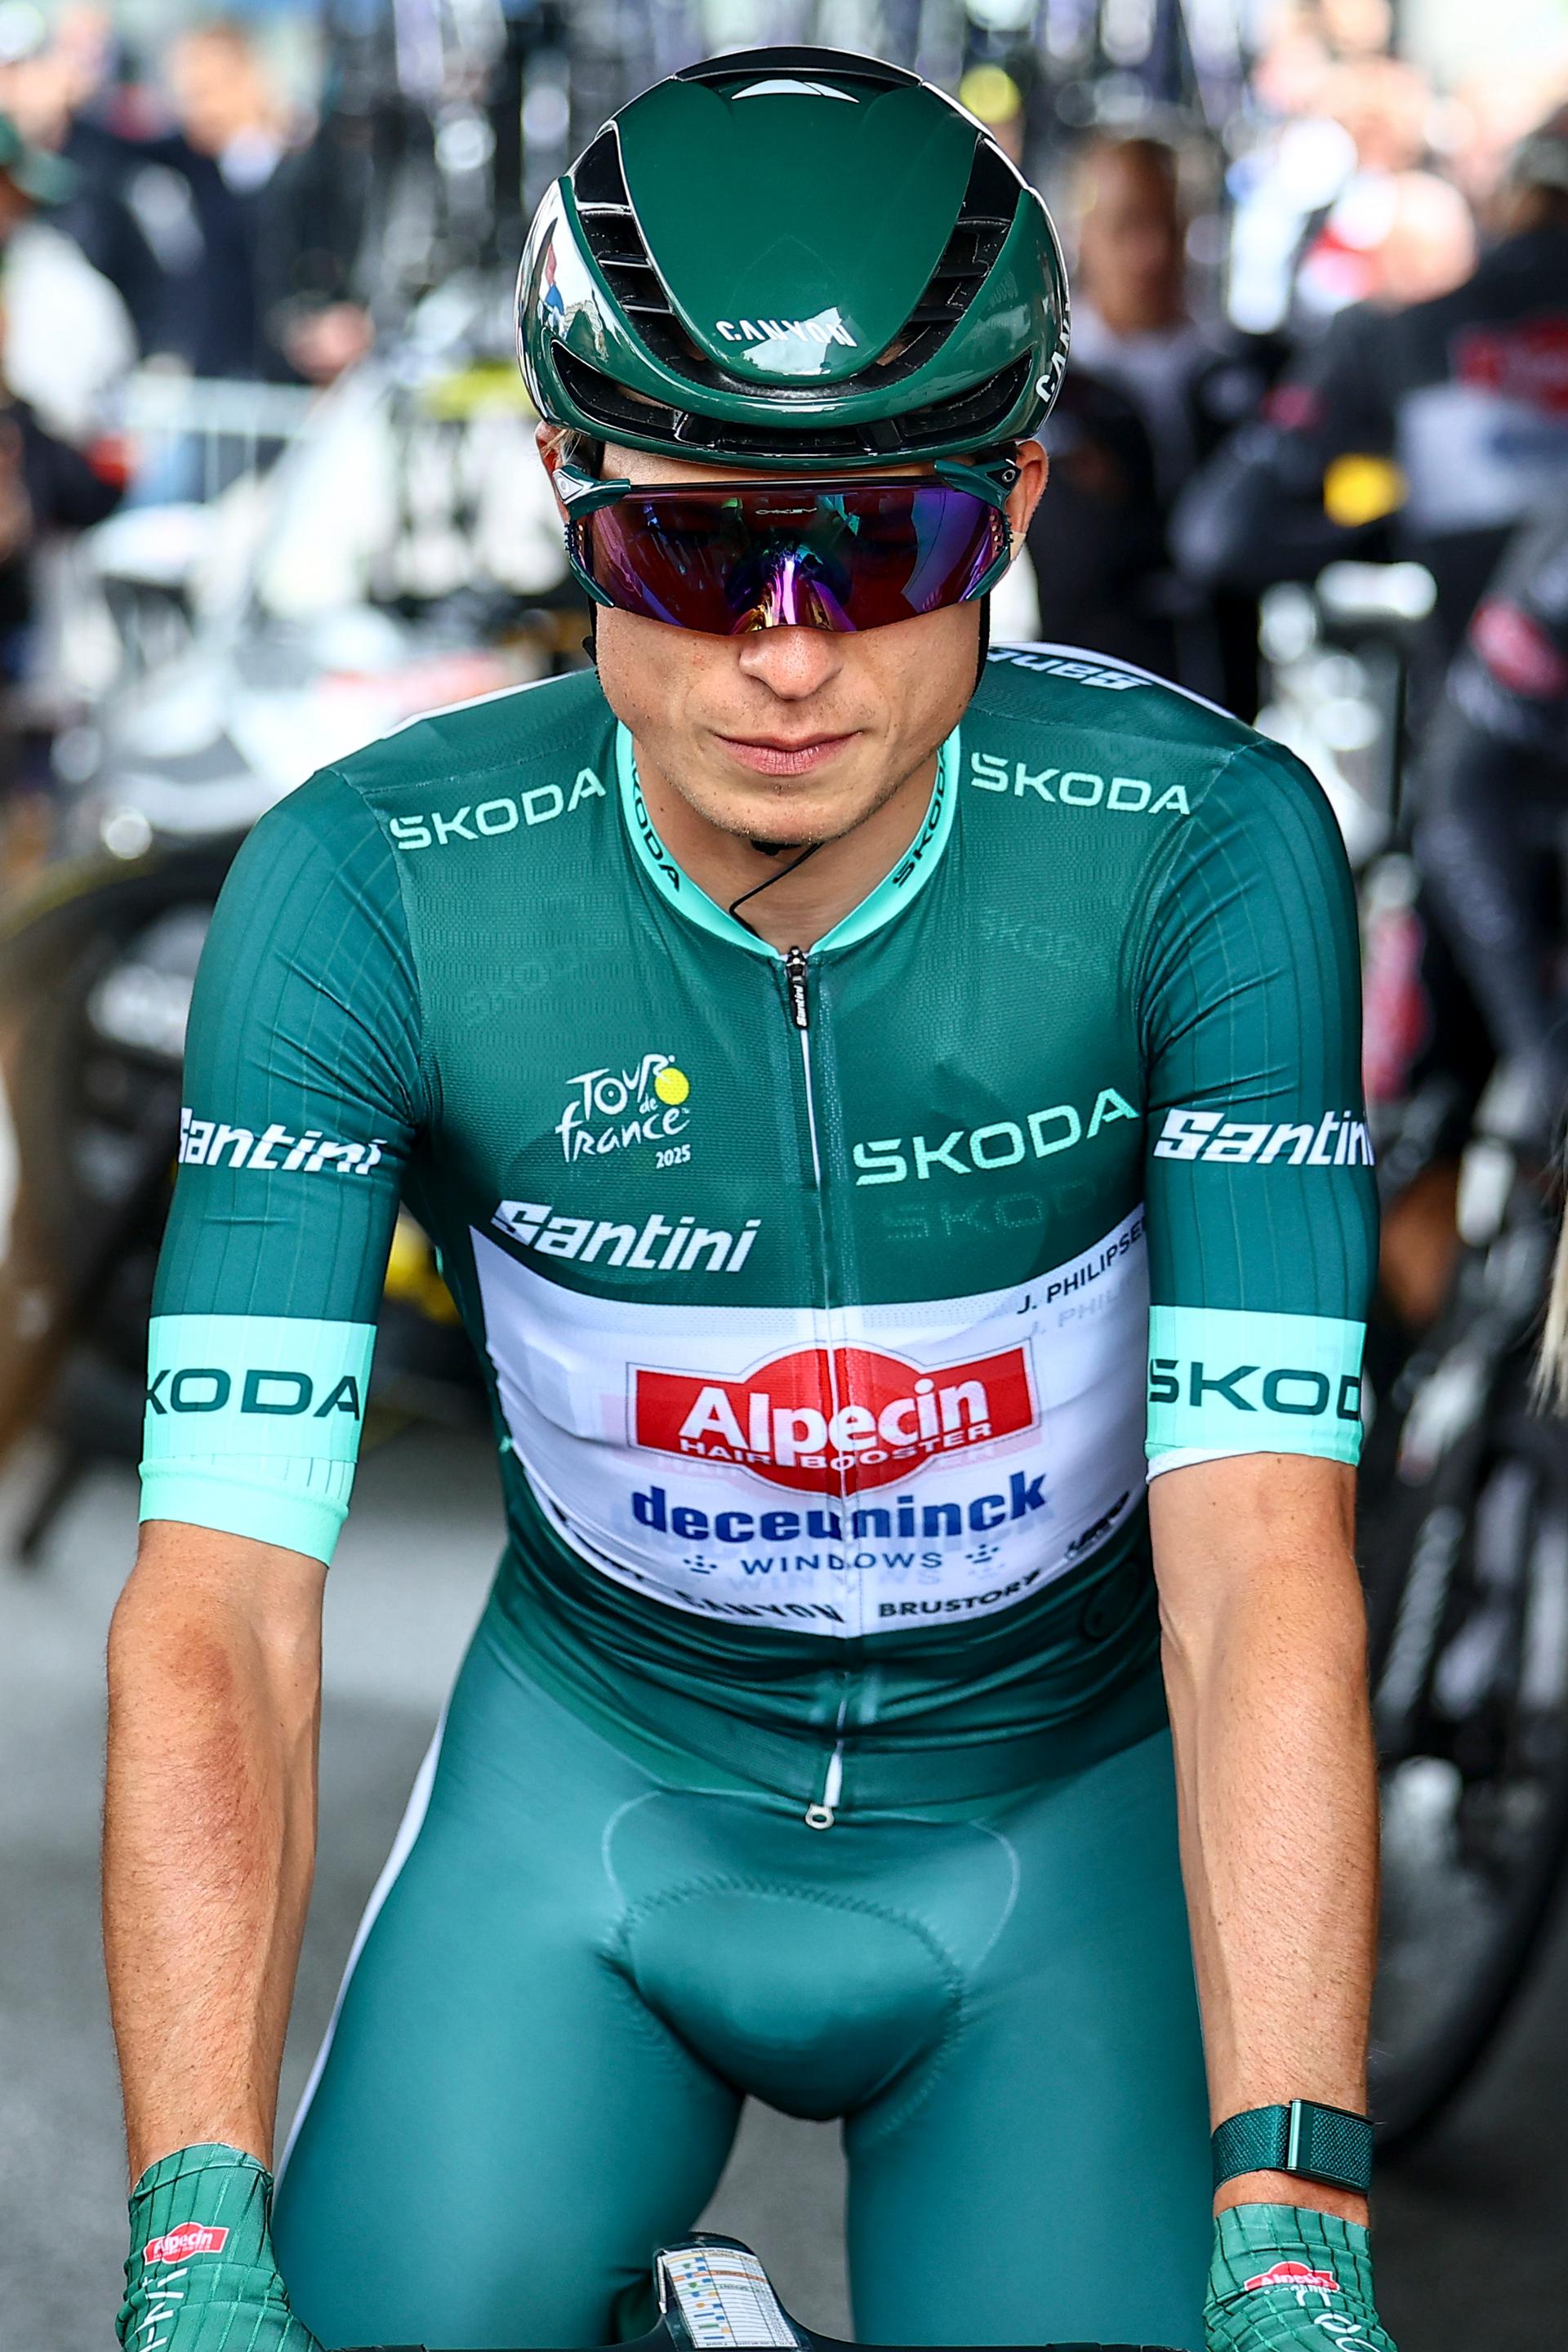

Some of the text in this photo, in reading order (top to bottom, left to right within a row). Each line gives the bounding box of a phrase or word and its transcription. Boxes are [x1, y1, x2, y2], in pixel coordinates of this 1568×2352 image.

[715, 319, 858, 347] CANYON
[388, 766, 607, 850] SKODA
[969, 751, 1191, 816] SKODA
[631, 758, 680, 892] KODA
[639, 1093, 658, 1114] de
[655, 1143, 692, 1169] 2025
[852, 1087, 1139, 1187] SKODA
[490, 1199, 762, 1272] Santini
[1017, 1215, 1145, 1315] J. PHILIPSE
[145, 1367, 361, 1421] KODA
[1148, 1357, 1360, 1421] SKO
[678, 1378, 990, 1468] Alpecin
[679, 1438, 772, 1465] HAIR
[800, 1422, 992, 1471] BOOSTER
[630, 1470, 1047, 1543] deceuninck
[741, 1551, 942, 1575] WINDOWS
[878, 1569, 1041, 1619] BRUSTORY
